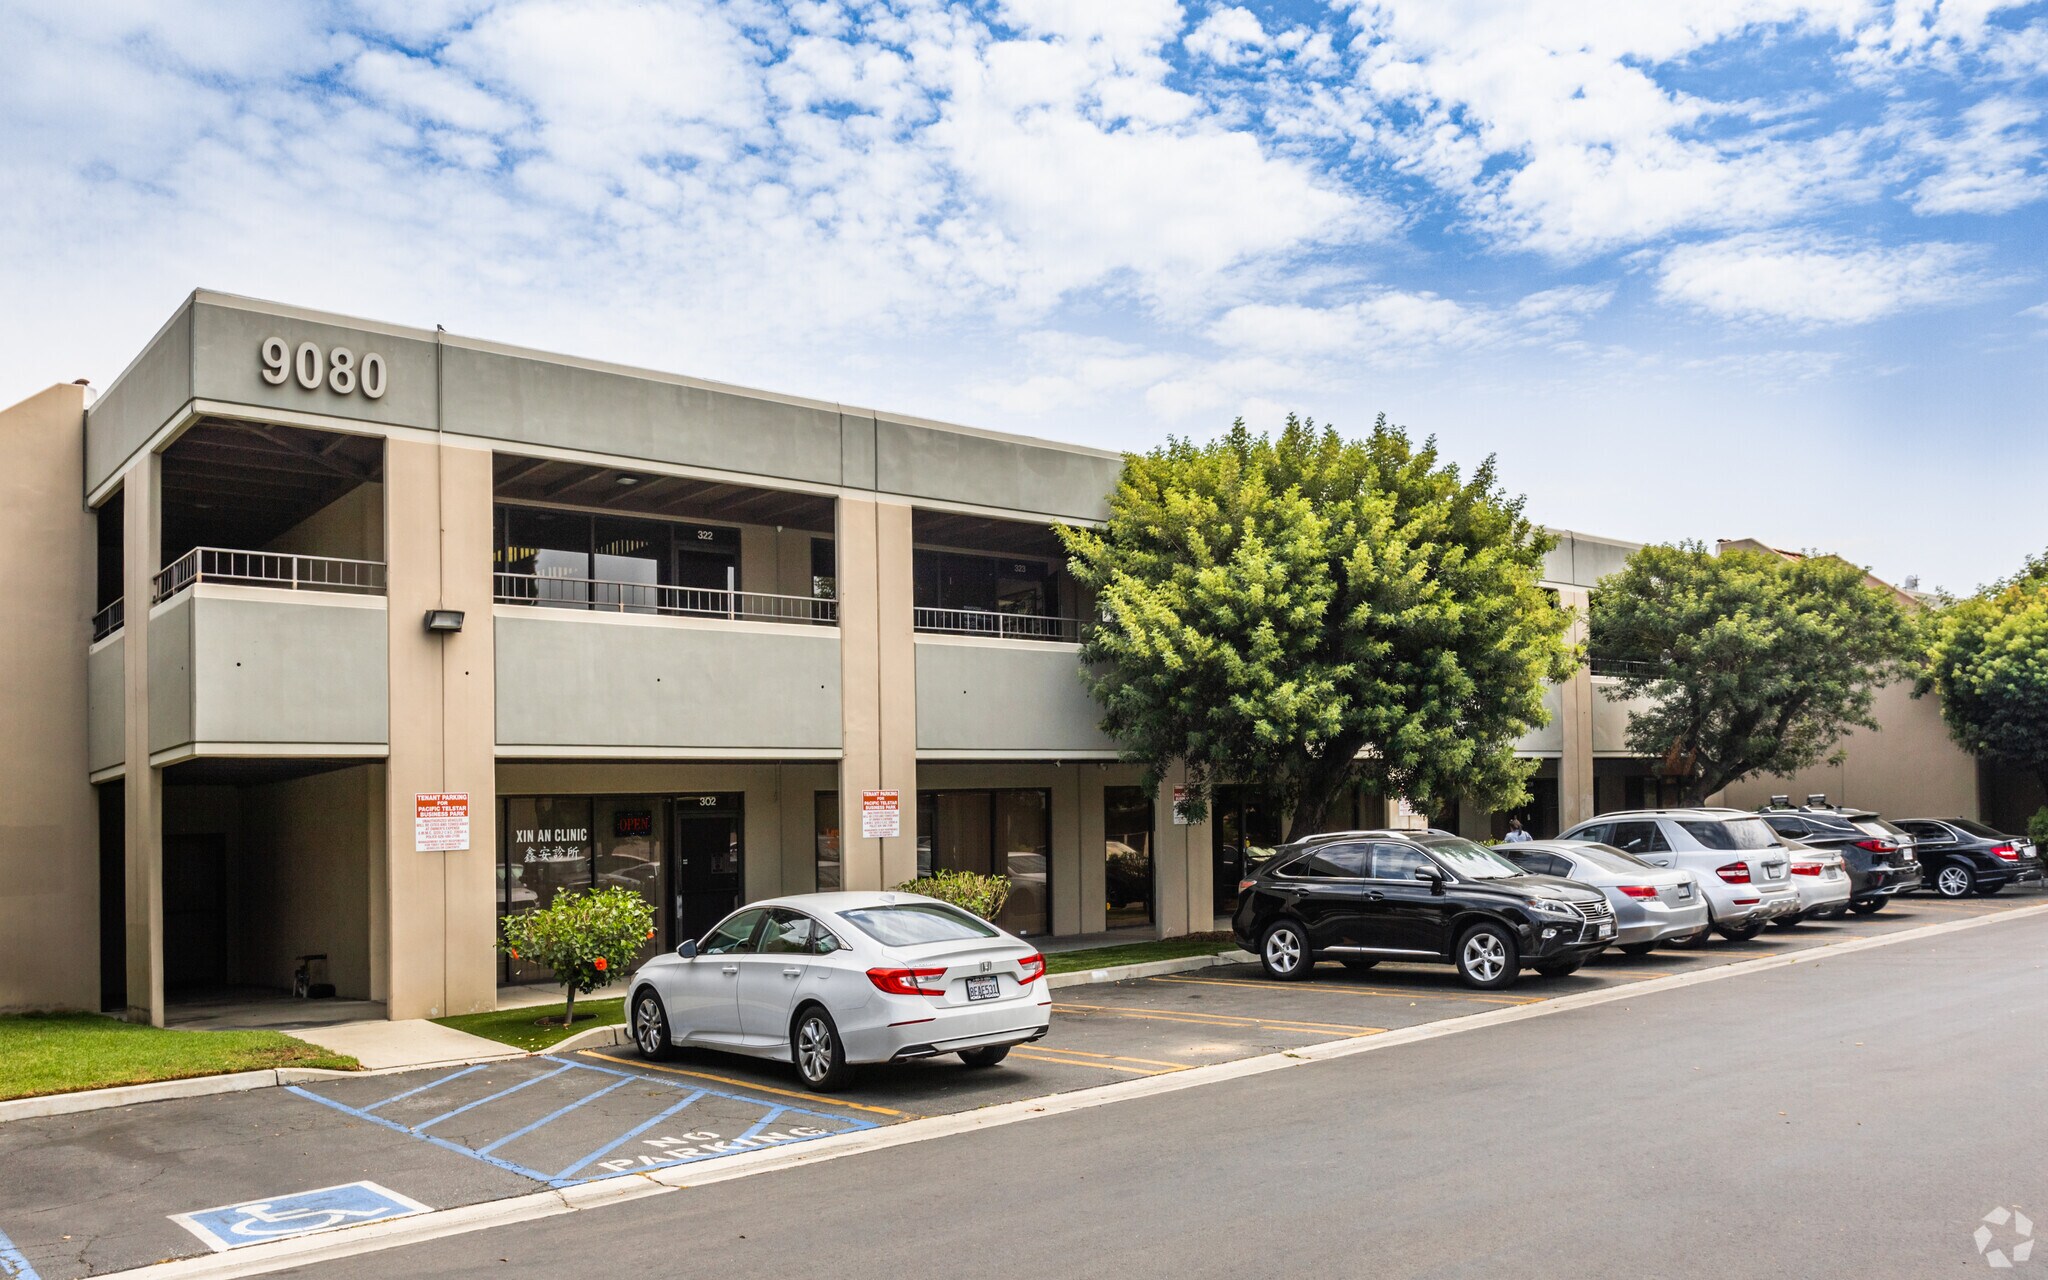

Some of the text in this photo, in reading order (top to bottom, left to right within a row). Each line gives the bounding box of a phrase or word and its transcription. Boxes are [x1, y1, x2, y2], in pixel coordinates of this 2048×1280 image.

[261, 336, 387, 399] 9080
[697, 530, 713, 540] 322
[700, 797, 716, 806] 302
[619, 817, 649, 831] OPEN
[516, 828, 587, 843] XIN AN CLINIC
[524, 846, 580, 863] 鑫安診所
[643, 1131, 721, 1148] NO
[598, 1126, 828, 1171] PARKING
